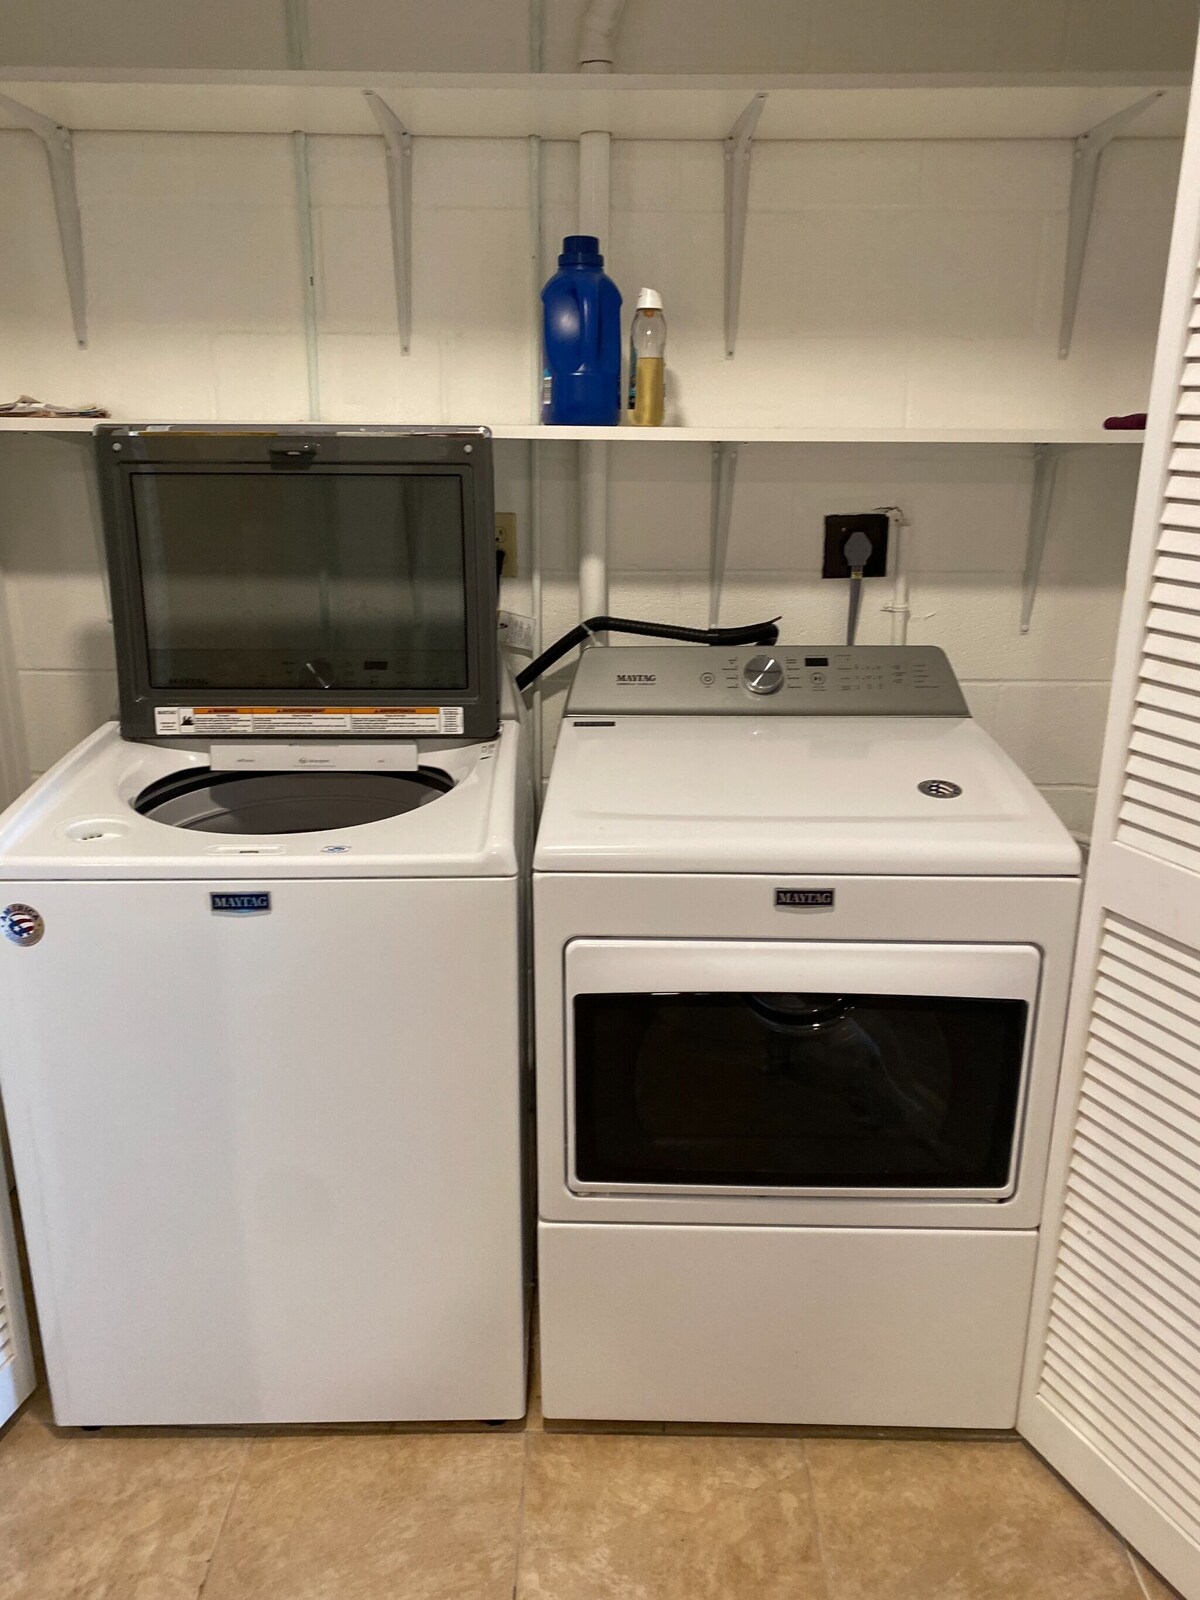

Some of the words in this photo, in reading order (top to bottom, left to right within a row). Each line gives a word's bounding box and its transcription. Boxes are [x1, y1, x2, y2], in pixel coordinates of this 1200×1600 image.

[616, 674, 656, 682] MAYTAG
[213, 896, 267, 907] MAYTAG
[779, 893, 832, 903] MAYTAG
